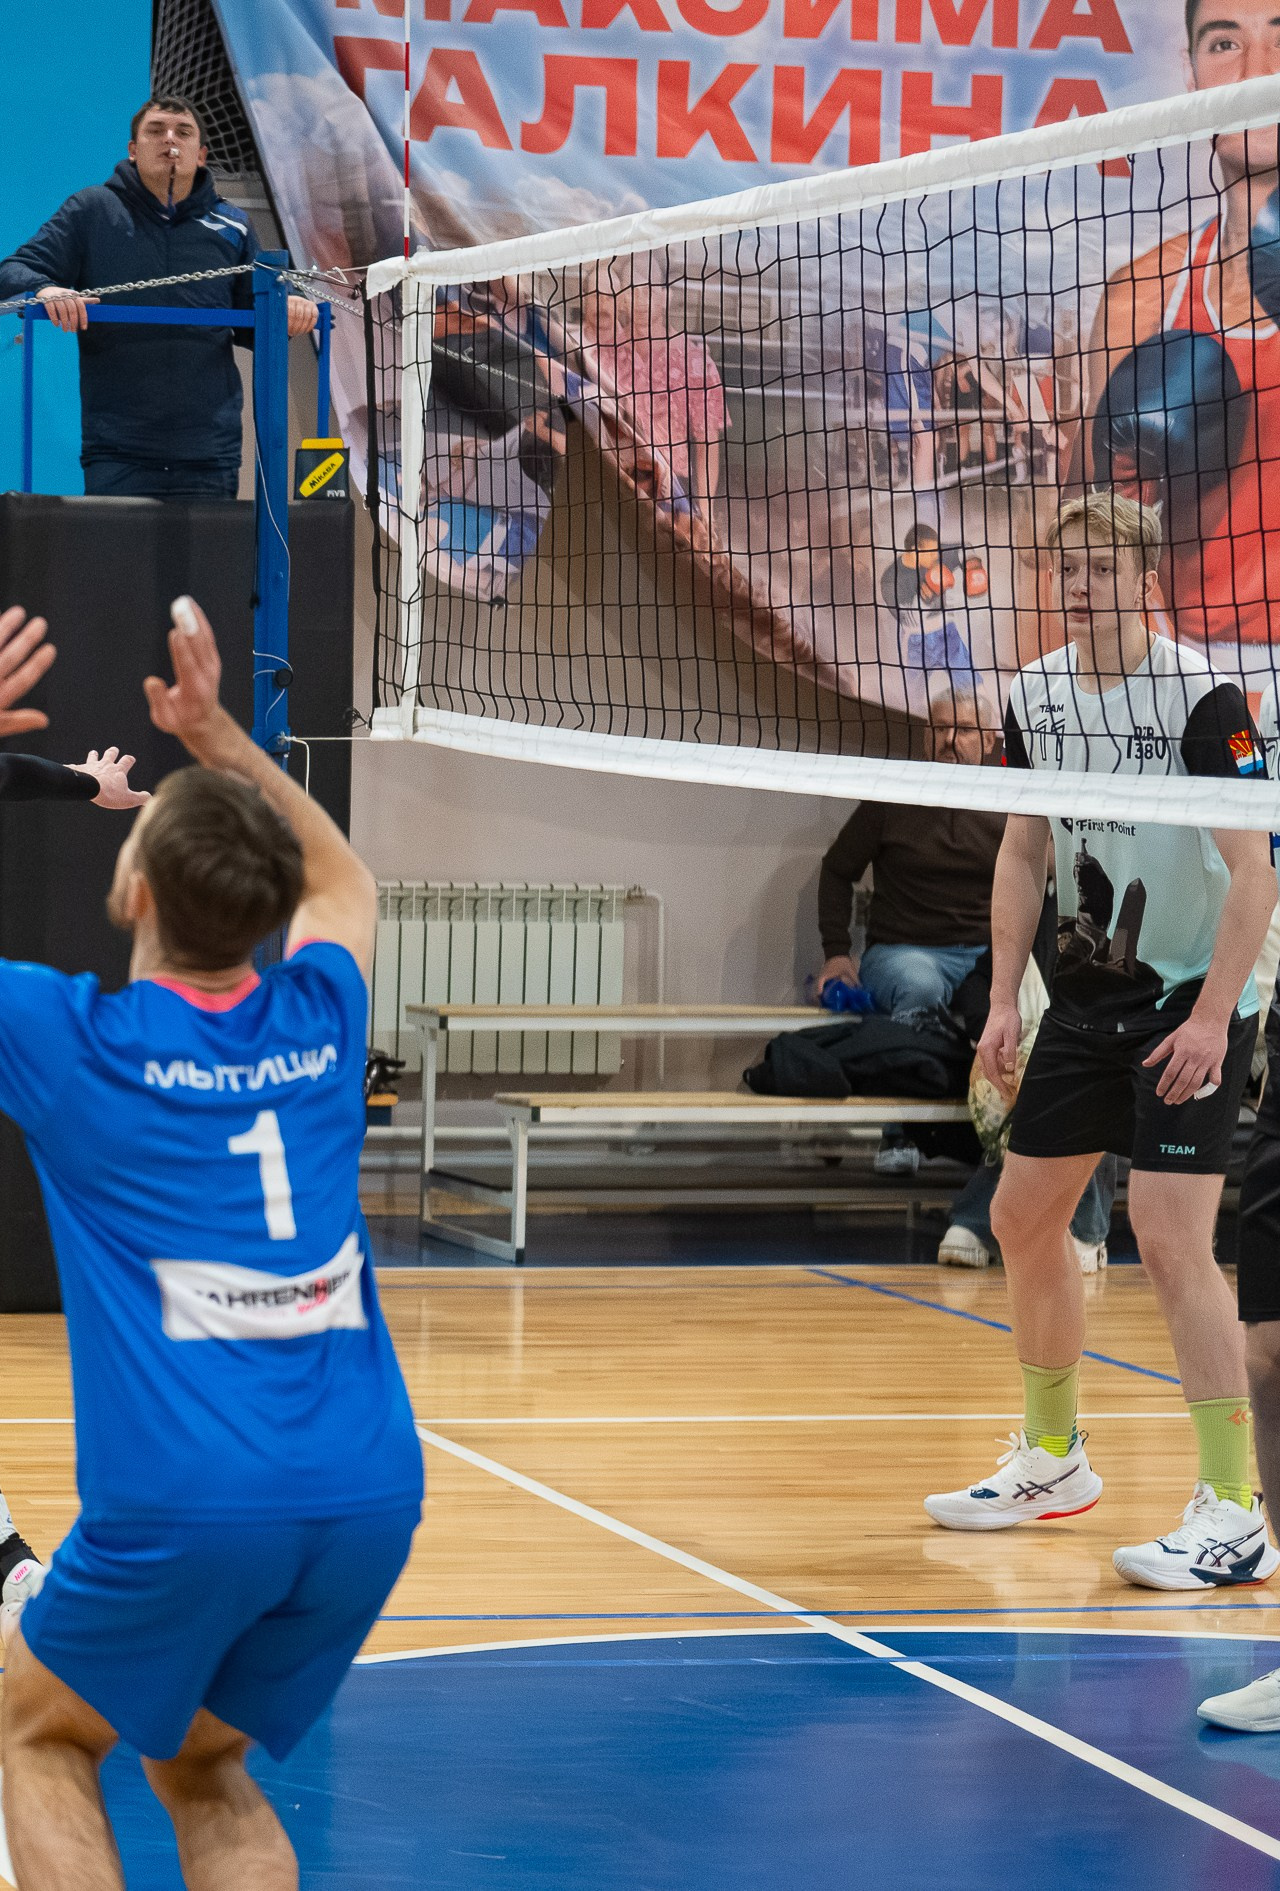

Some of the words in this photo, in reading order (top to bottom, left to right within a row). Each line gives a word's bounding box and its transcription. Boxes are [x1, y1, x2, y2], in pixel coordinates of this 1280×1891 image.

[1039, 703, 1065, 714] TEAM
[1075, 818, 1105, 833] First
[1106, 820, 1137, 837] Point
[144, 1043, 337, 1093] МЫТИЩИ
[1159, 1143, 1197, 1156] TEAM
[228, 1110, 297, 1241] 1
